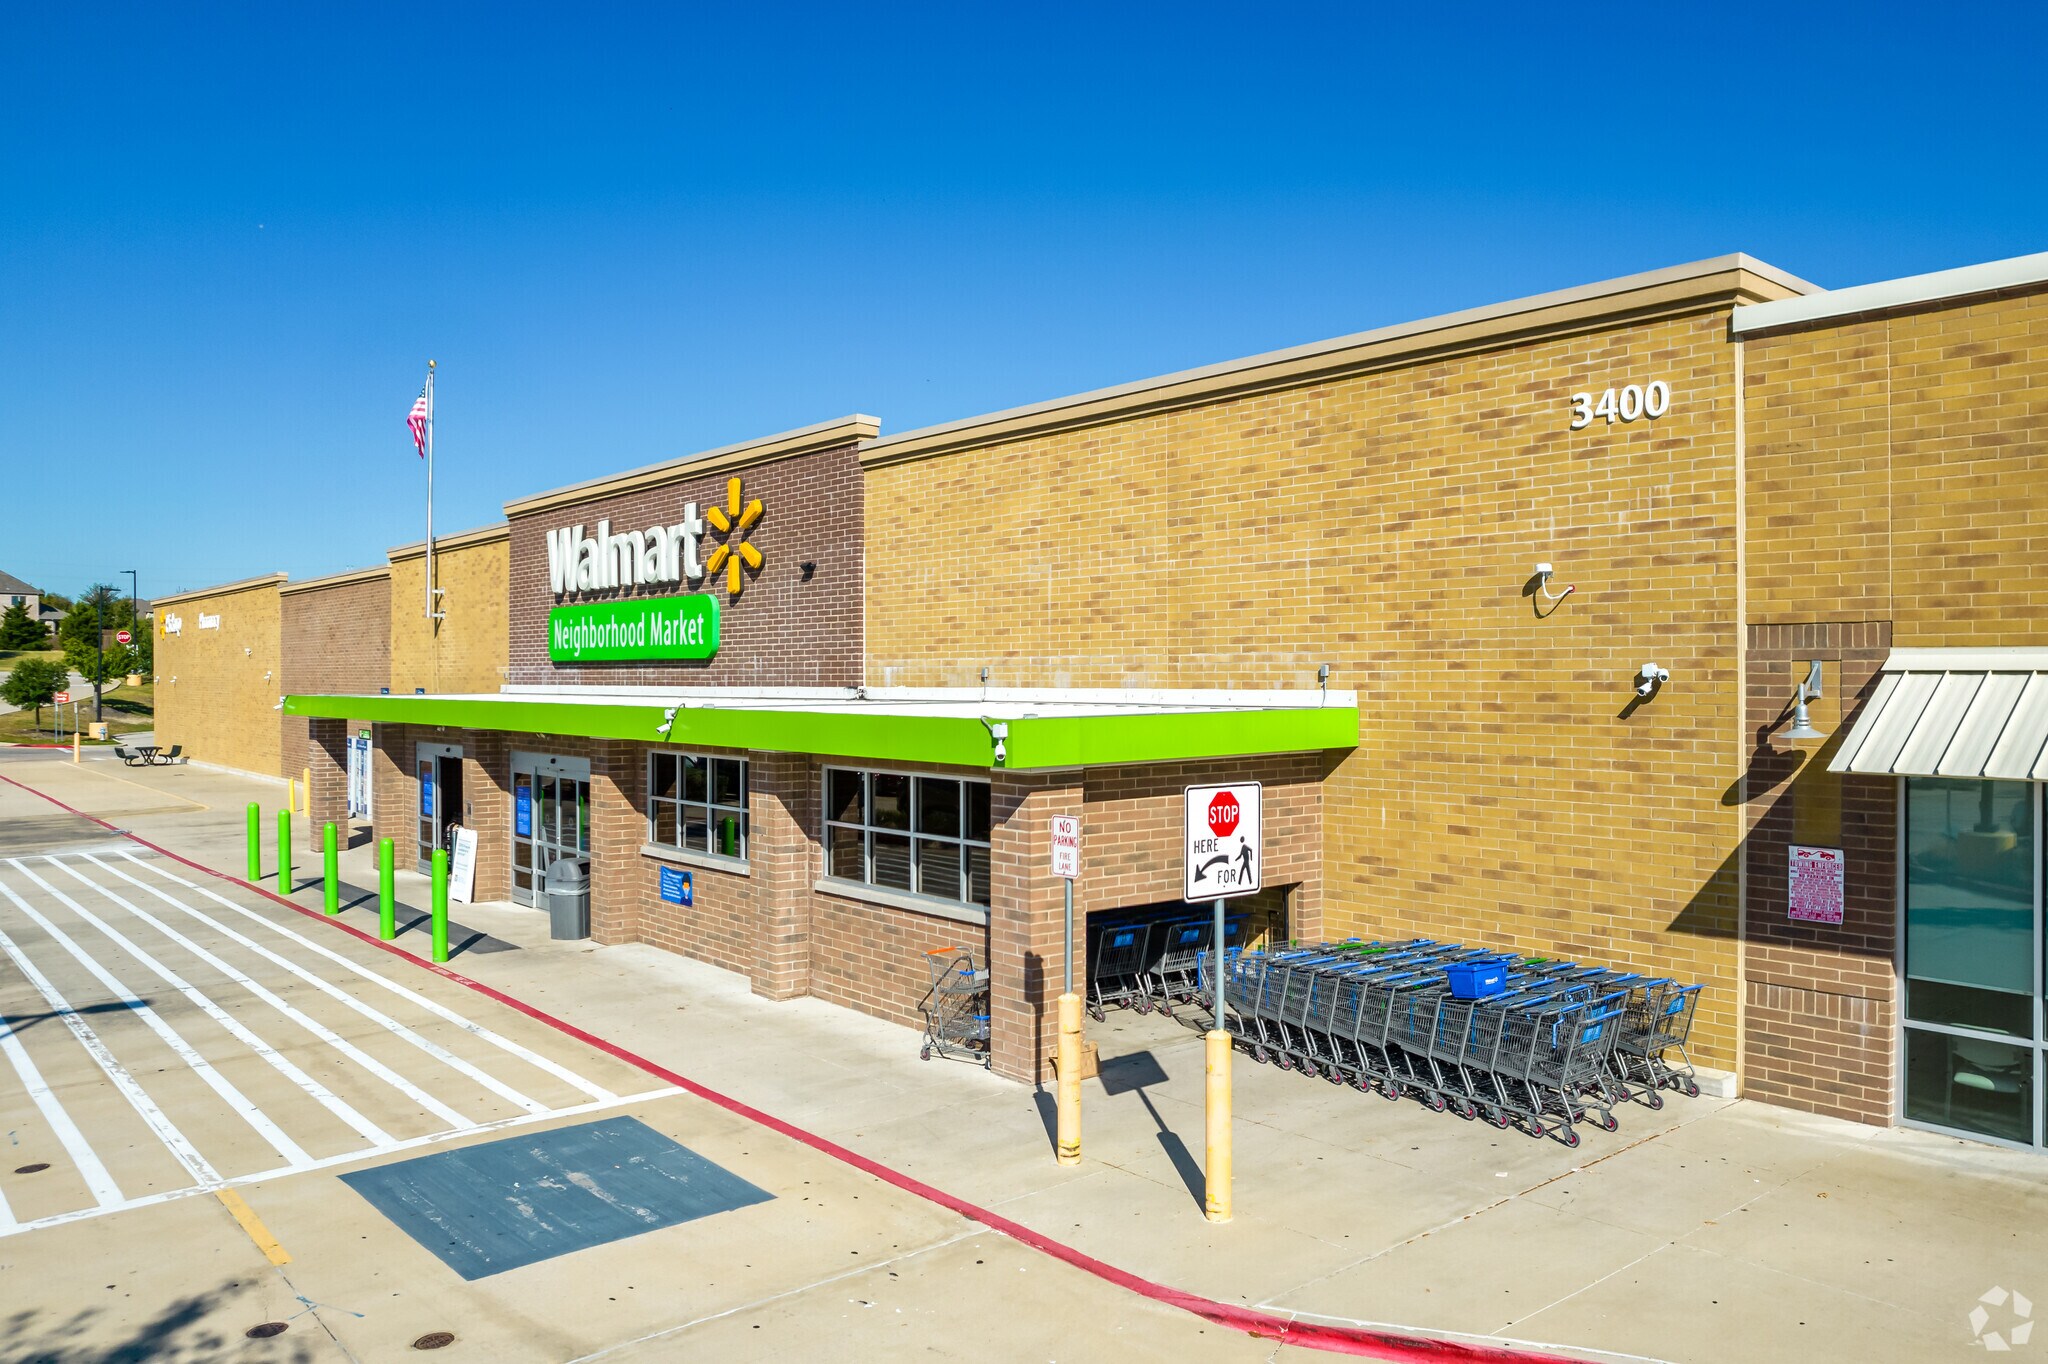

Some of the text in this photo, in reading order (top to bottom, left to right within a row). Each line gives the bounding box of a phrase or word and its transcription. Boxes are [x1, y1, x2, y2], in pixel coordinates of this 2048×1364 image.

[1571, 380, 1670, 429] 3400
[546, 502, 703, 594] Walmart
[554, 609, 704, 657] Neighborhood Market
[1209, 805, 1239, 824] STOP
[1059, 821, 1071, 833] NO
[1053, 835, 1077, 847] PARKING
[1193, 838, 1219, 854] HERE
[1059, 852, 1071, 861] FIRE
[1058, 862, 1072, 871] LANE
[1217, 869, 1236, 884] FOR
